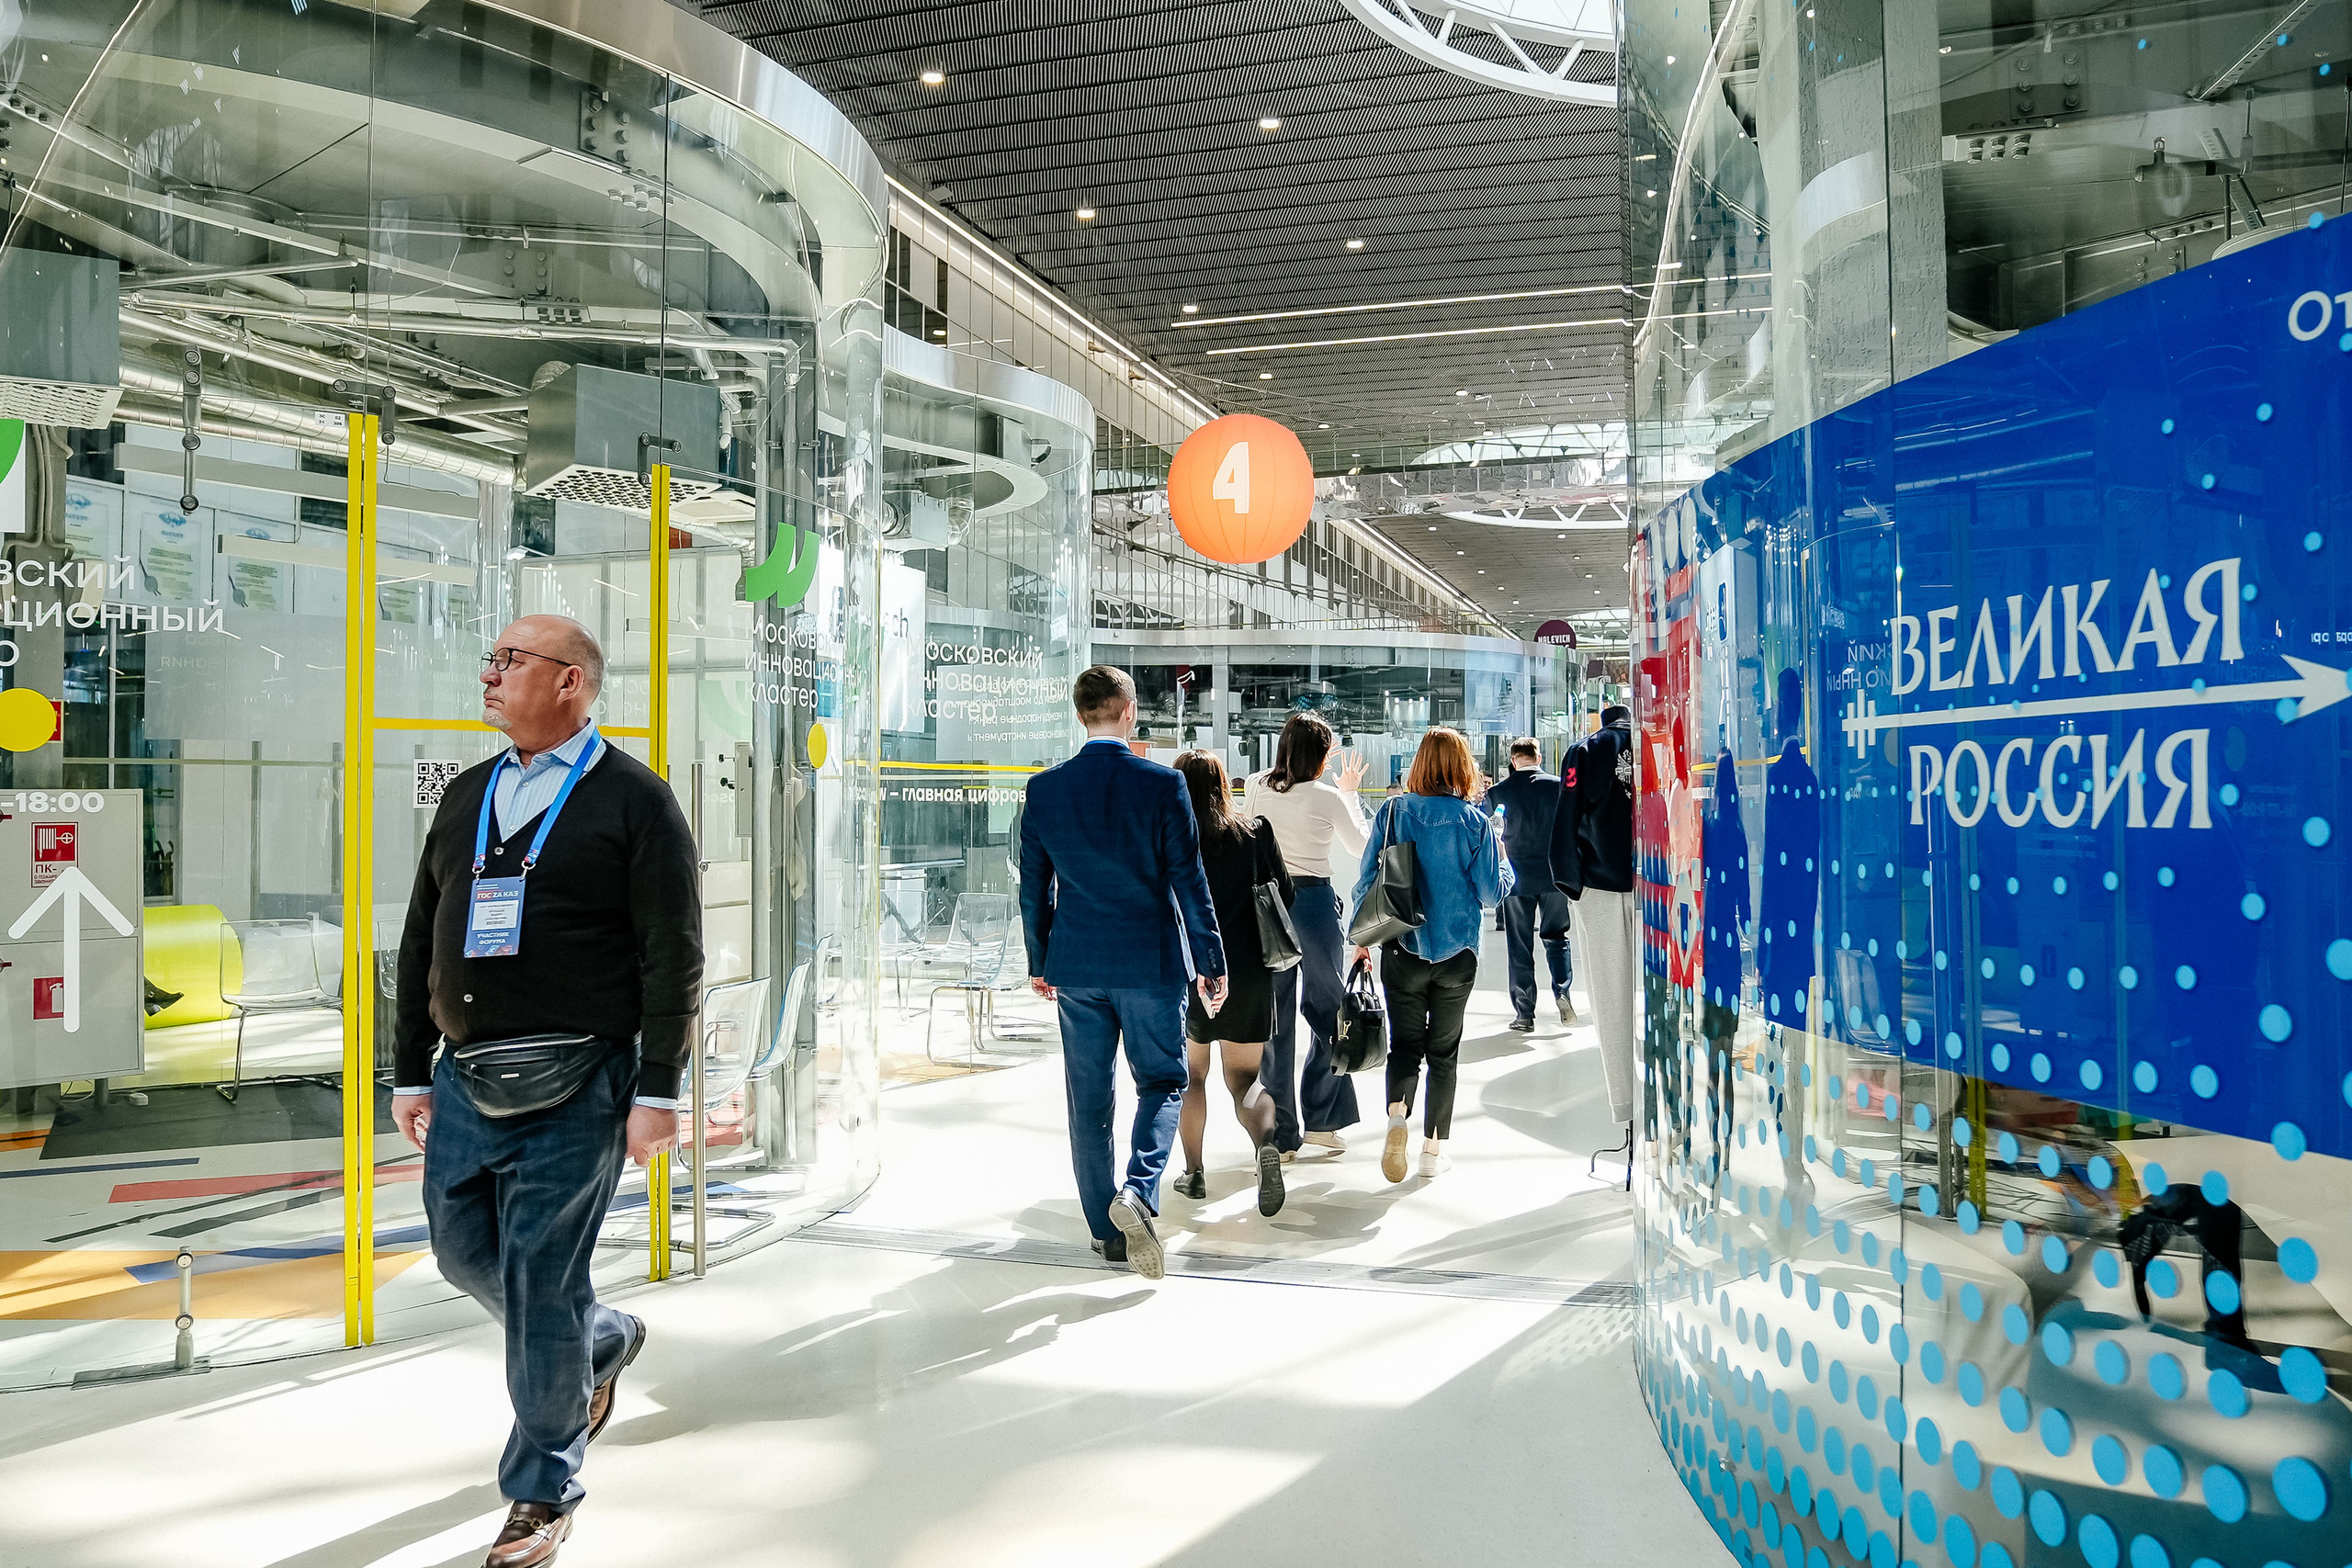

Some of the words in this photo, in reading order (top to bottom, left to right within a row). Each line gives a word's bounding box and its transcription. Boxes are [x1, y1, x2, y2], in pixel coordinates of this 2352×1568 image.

[1213, 442, 1250, 514] 4
[1537, 634, 1570, 644] MALEVICH
[1890, 557, 2245, 696] ВЕЛИКАЯ
[925, 641, 1044, 671] осковский
[902, 787, 964, 802] главная
[967, 785, 1027, 806] цифров
[1908, 728, 2212, 829] РОССИЯ
